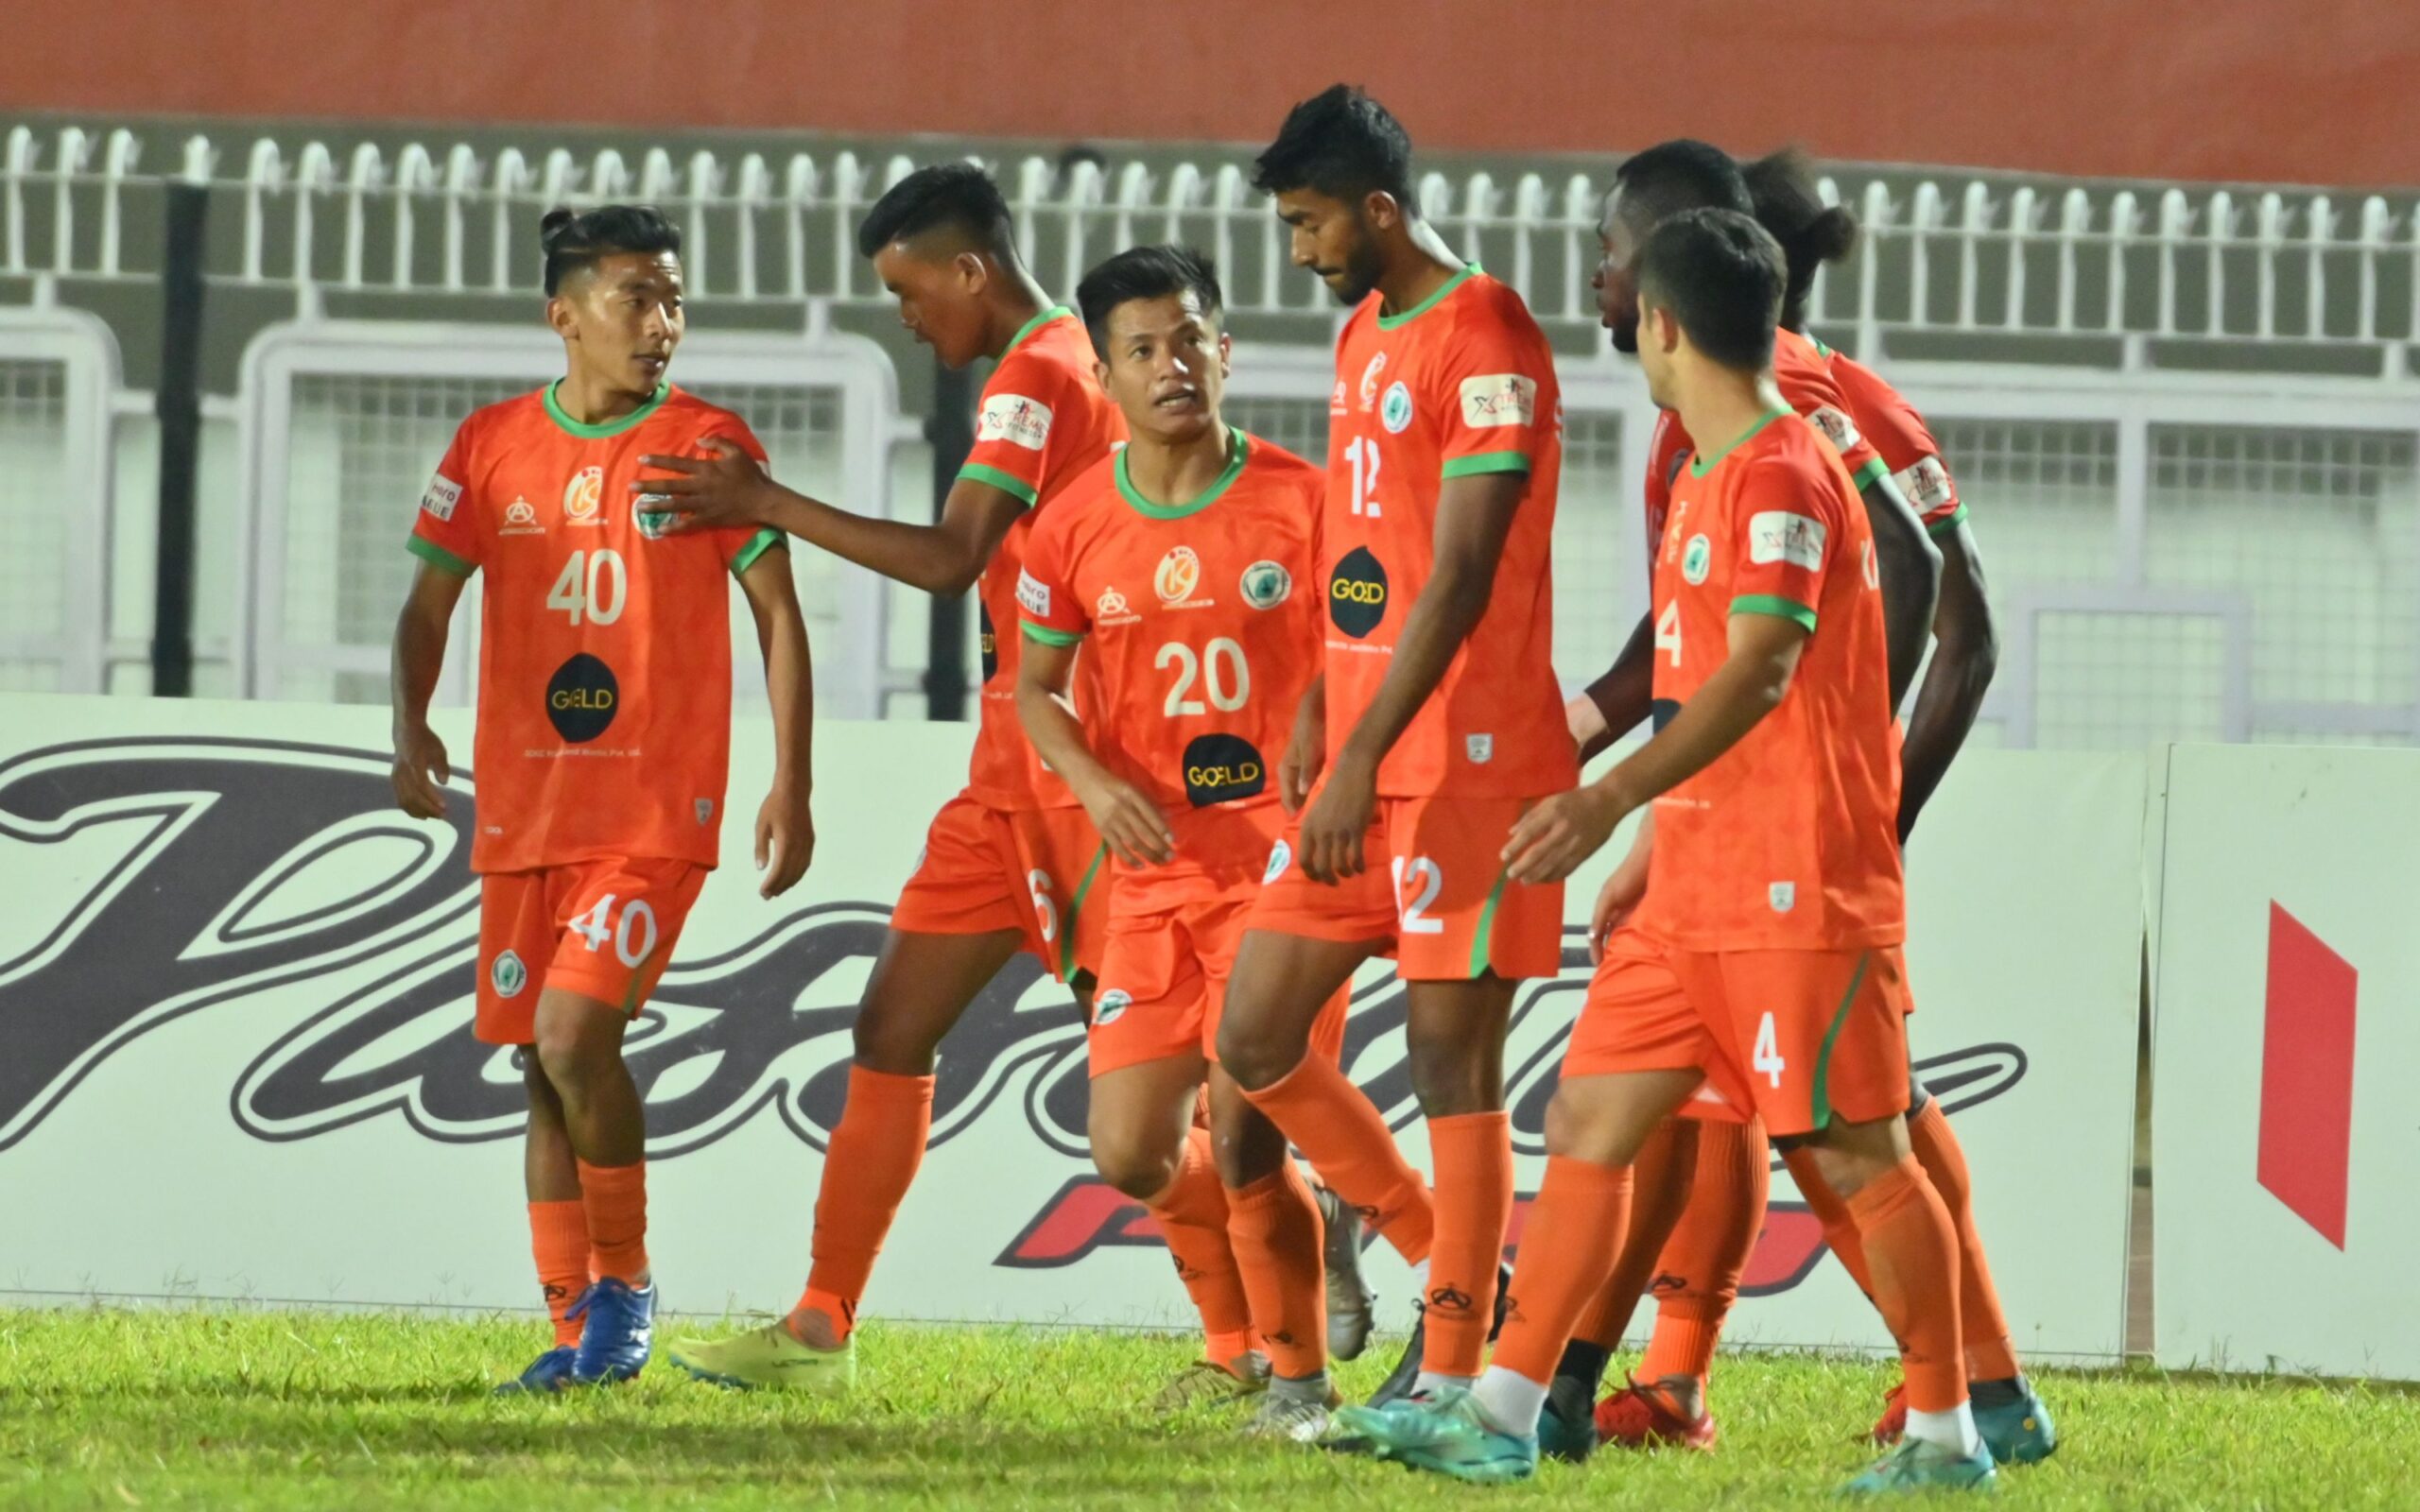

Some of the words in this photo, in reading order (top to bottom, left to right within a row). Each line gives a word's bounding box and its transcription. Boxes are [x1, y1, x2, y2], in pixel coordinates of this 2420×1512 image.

[545, 548, 627, 626] 40
[1154, 637, 1251, 718] 20
[568, 893, 657, 969] 40
[1753, 1011, 1785, 1089] 4
